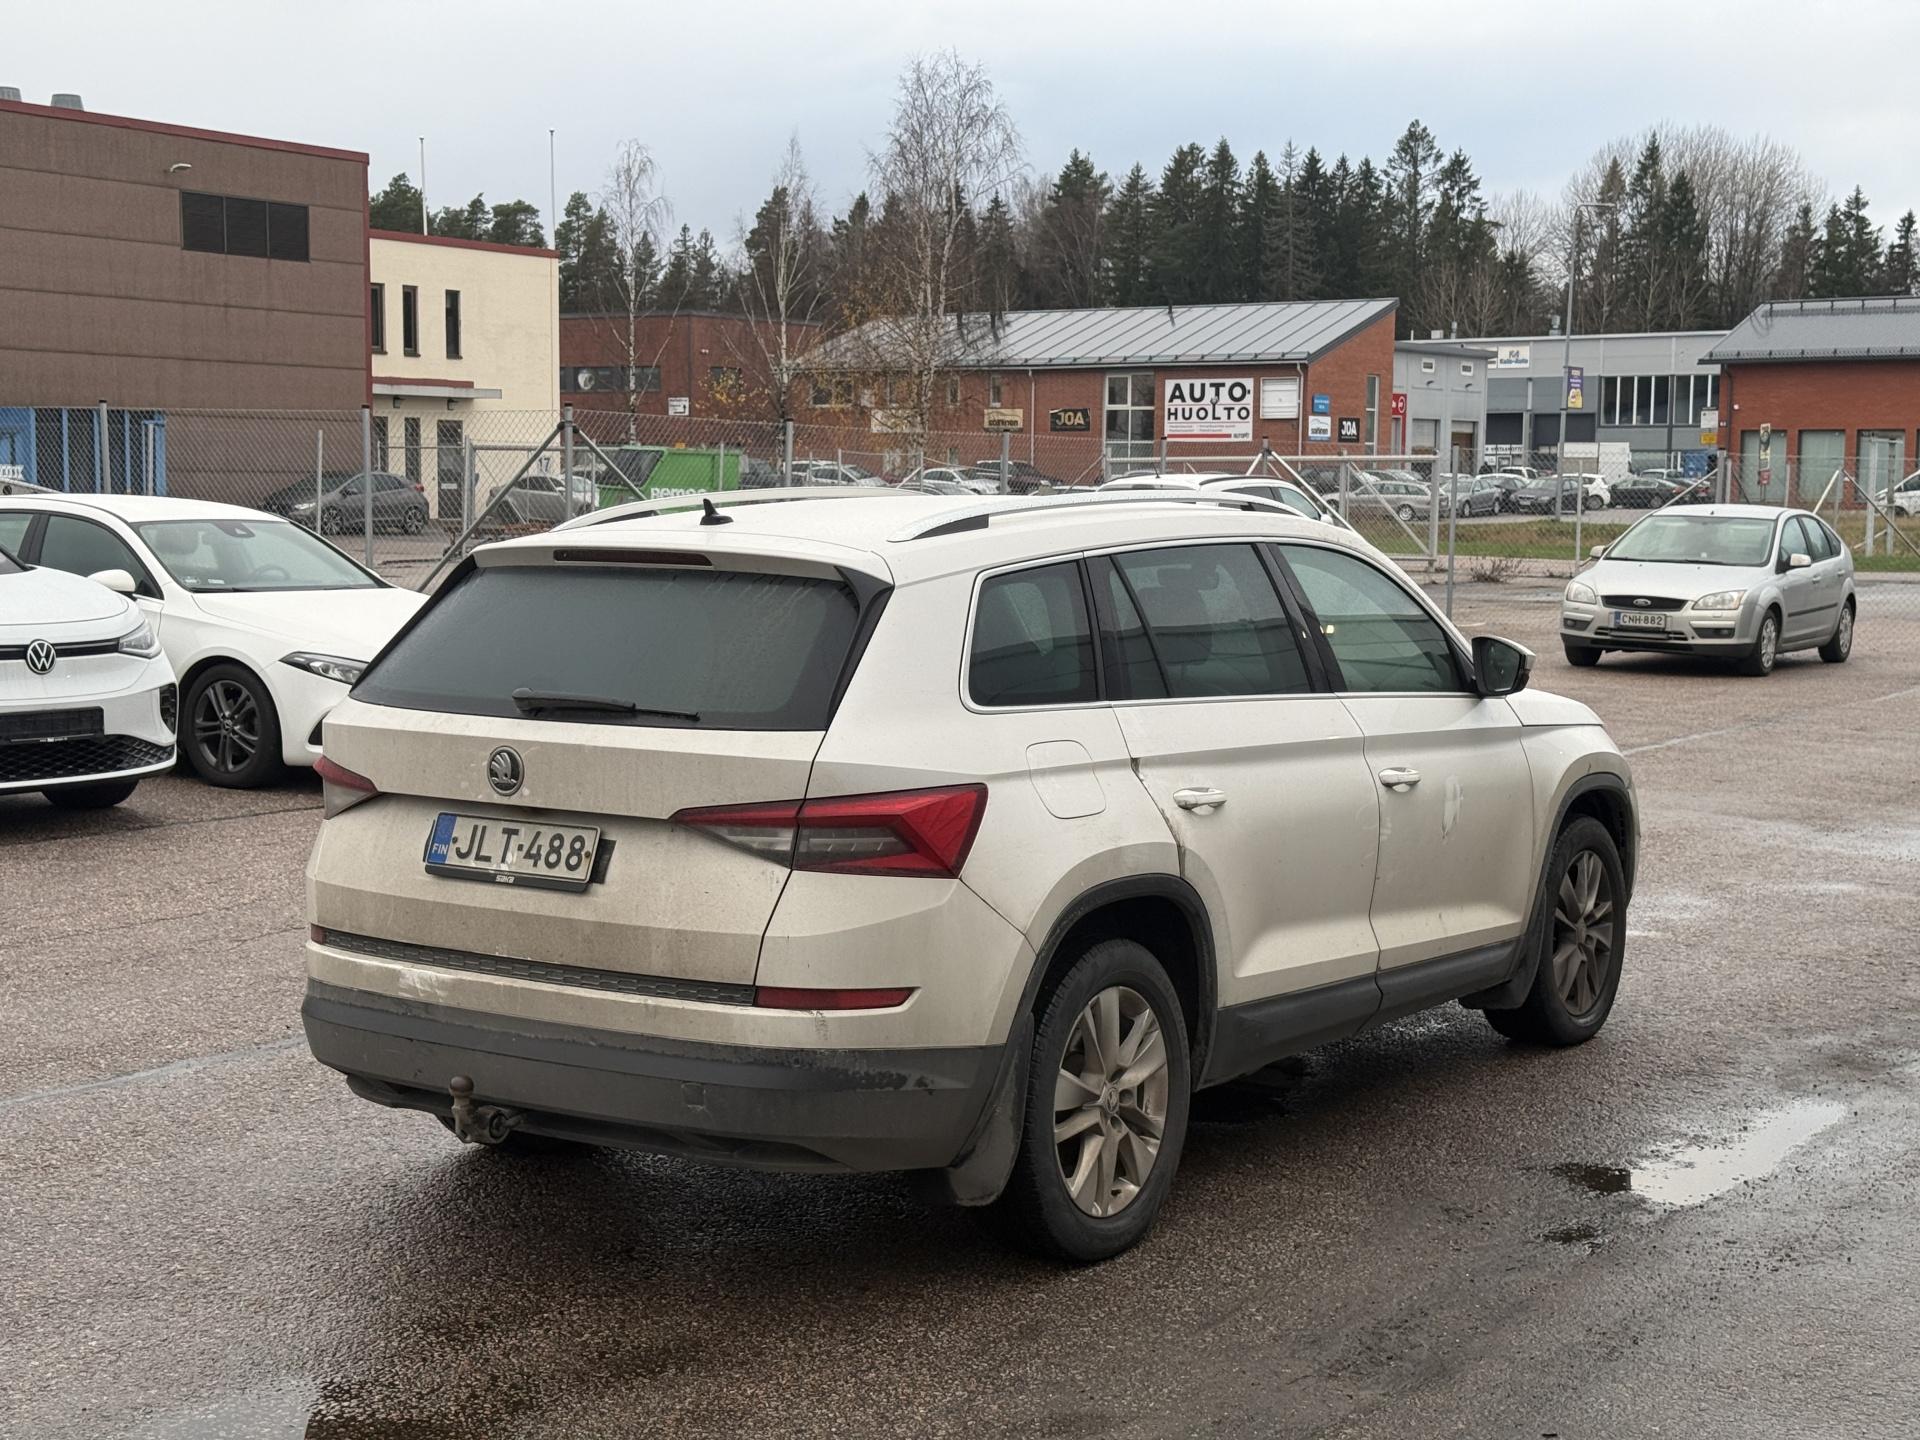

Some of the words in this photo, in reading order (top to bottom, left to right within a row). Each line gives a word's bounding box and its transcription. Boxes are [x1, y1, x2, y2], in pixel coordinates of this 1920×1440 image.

[1056, 411, 1084, 426] JOA
[1167, 406, 1250, 420] HUOLTO
[1341, 421, 1357, 435] JOA
[1622, 613, 1663, 626] CNH-882
[432, 843, 449, 855] FIN
[455, 824, 586, 872] JLT-488
